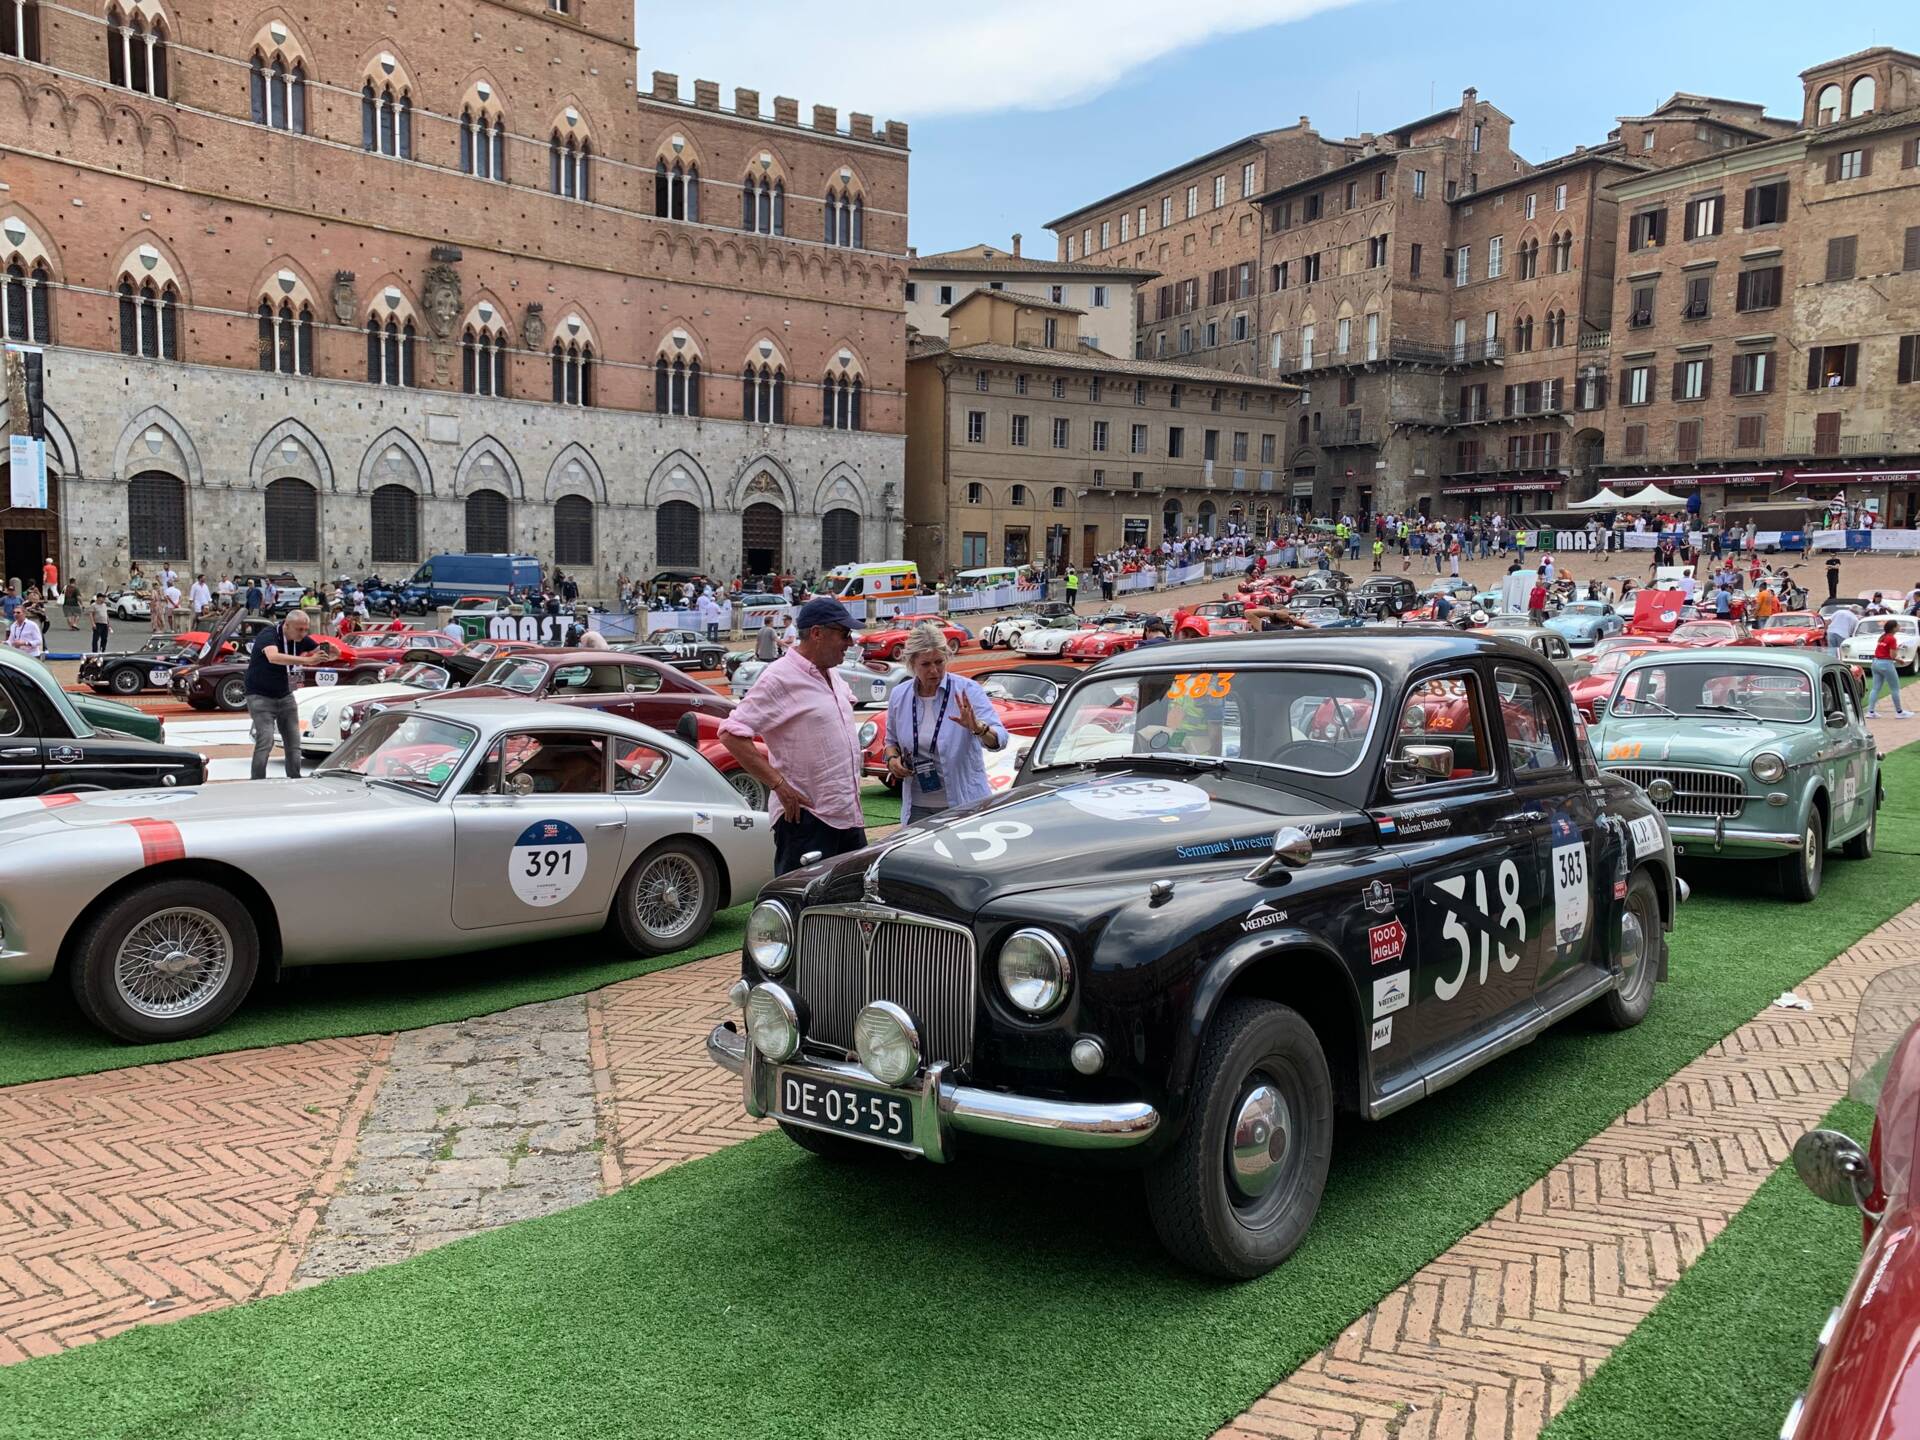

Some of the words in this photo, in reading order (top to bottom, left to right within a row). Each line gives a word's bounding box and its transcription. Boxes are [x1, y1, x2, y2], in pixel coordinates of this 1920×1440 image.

[1556, 530, 1613, 550] MAST
[489, 615, 574, 648] MAST
[318, 673, 335, 682] 305
[1167, 672, 1236, 699] 383
[1080, 781, 1171, 800] 383
[1176, 839, 1231, 859] Semmats
[525, 849, 572, 877] 391
[1558, 850, 1583, 889] 383
[1240, 910, 1289, 932] VREDESTEIN
[1373, 926, 1397, 944] 1000
[1373, 942, 1401, 960] MIGLIA
[1374, 1024, 1390, 1041] MAX
